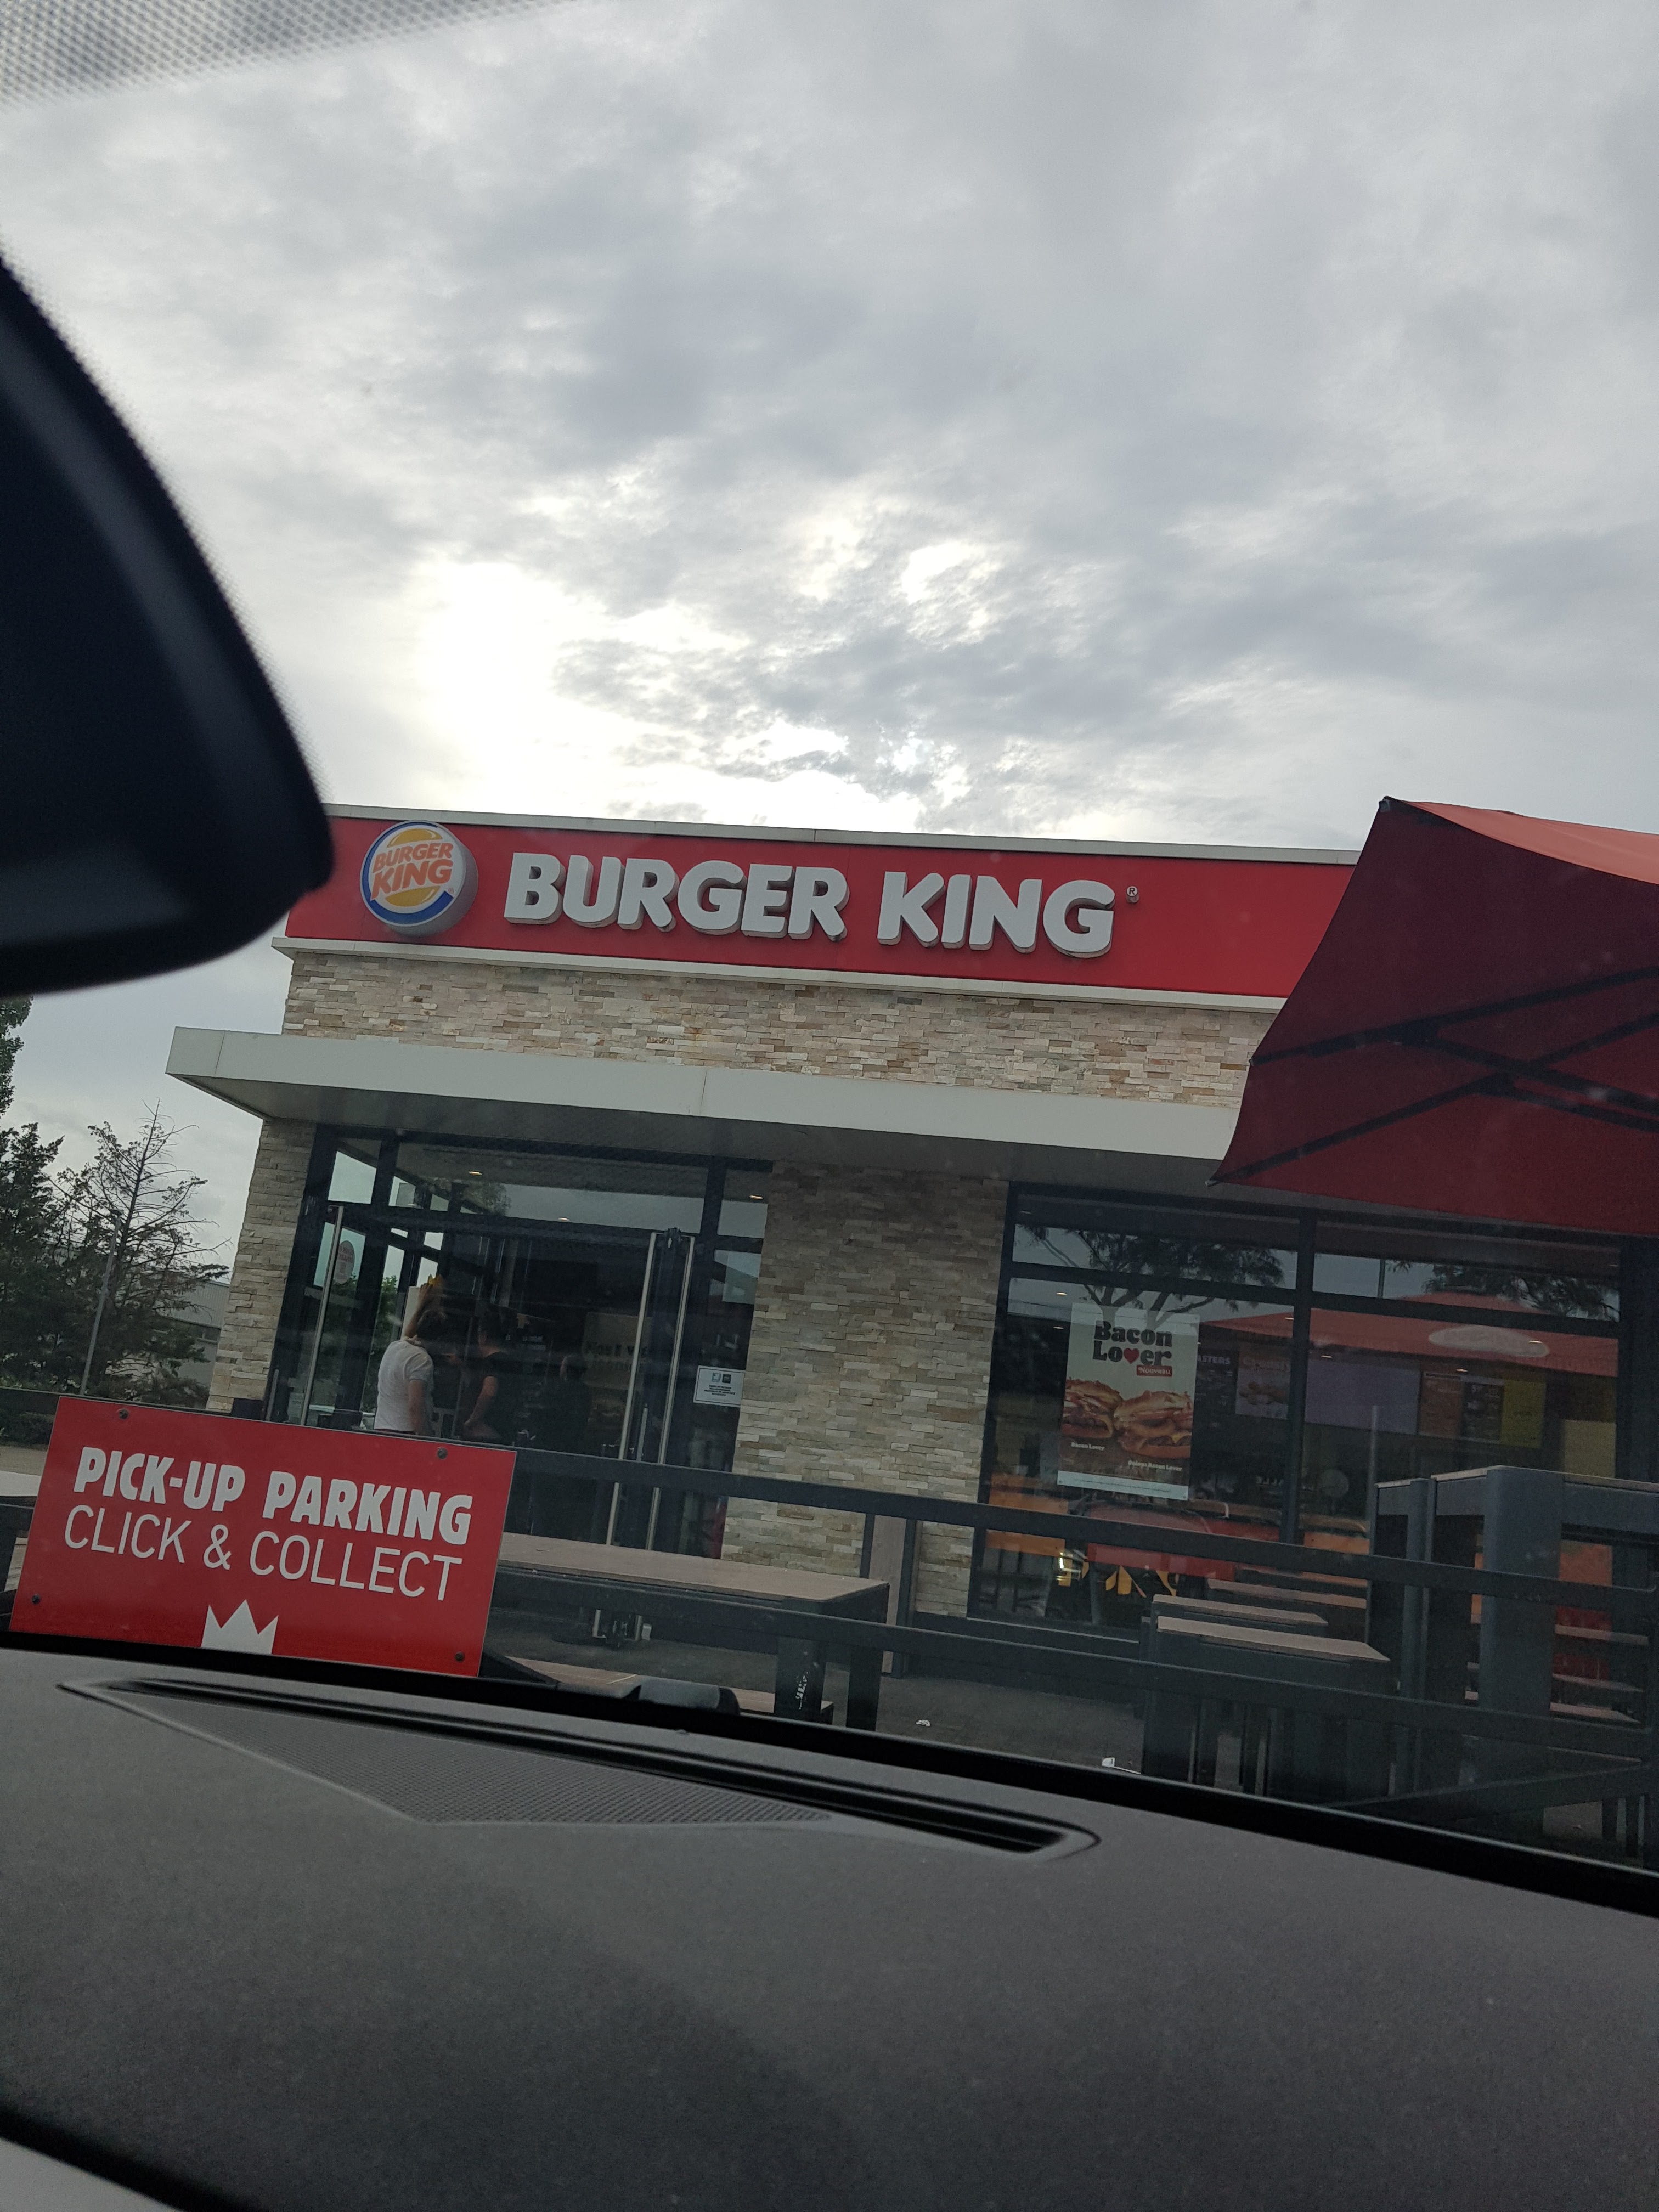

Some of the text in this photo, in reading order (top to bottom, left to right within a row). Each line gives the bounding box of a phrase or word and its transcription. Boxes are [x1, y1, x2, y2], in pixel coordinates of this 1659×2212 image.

[371, 859, 454, 899] KING
[373, 843, 454, 873] BURGER
[504, 852, 849, 941] BURGER
[877, 871, 1116, 958] KING
[1094, 1320, 1172, 1347] Bacon
[74, 1447, 473, 1545] PICK-UP PARKING
[64, 1504, 463, 1601] CLICK & COLLECT
